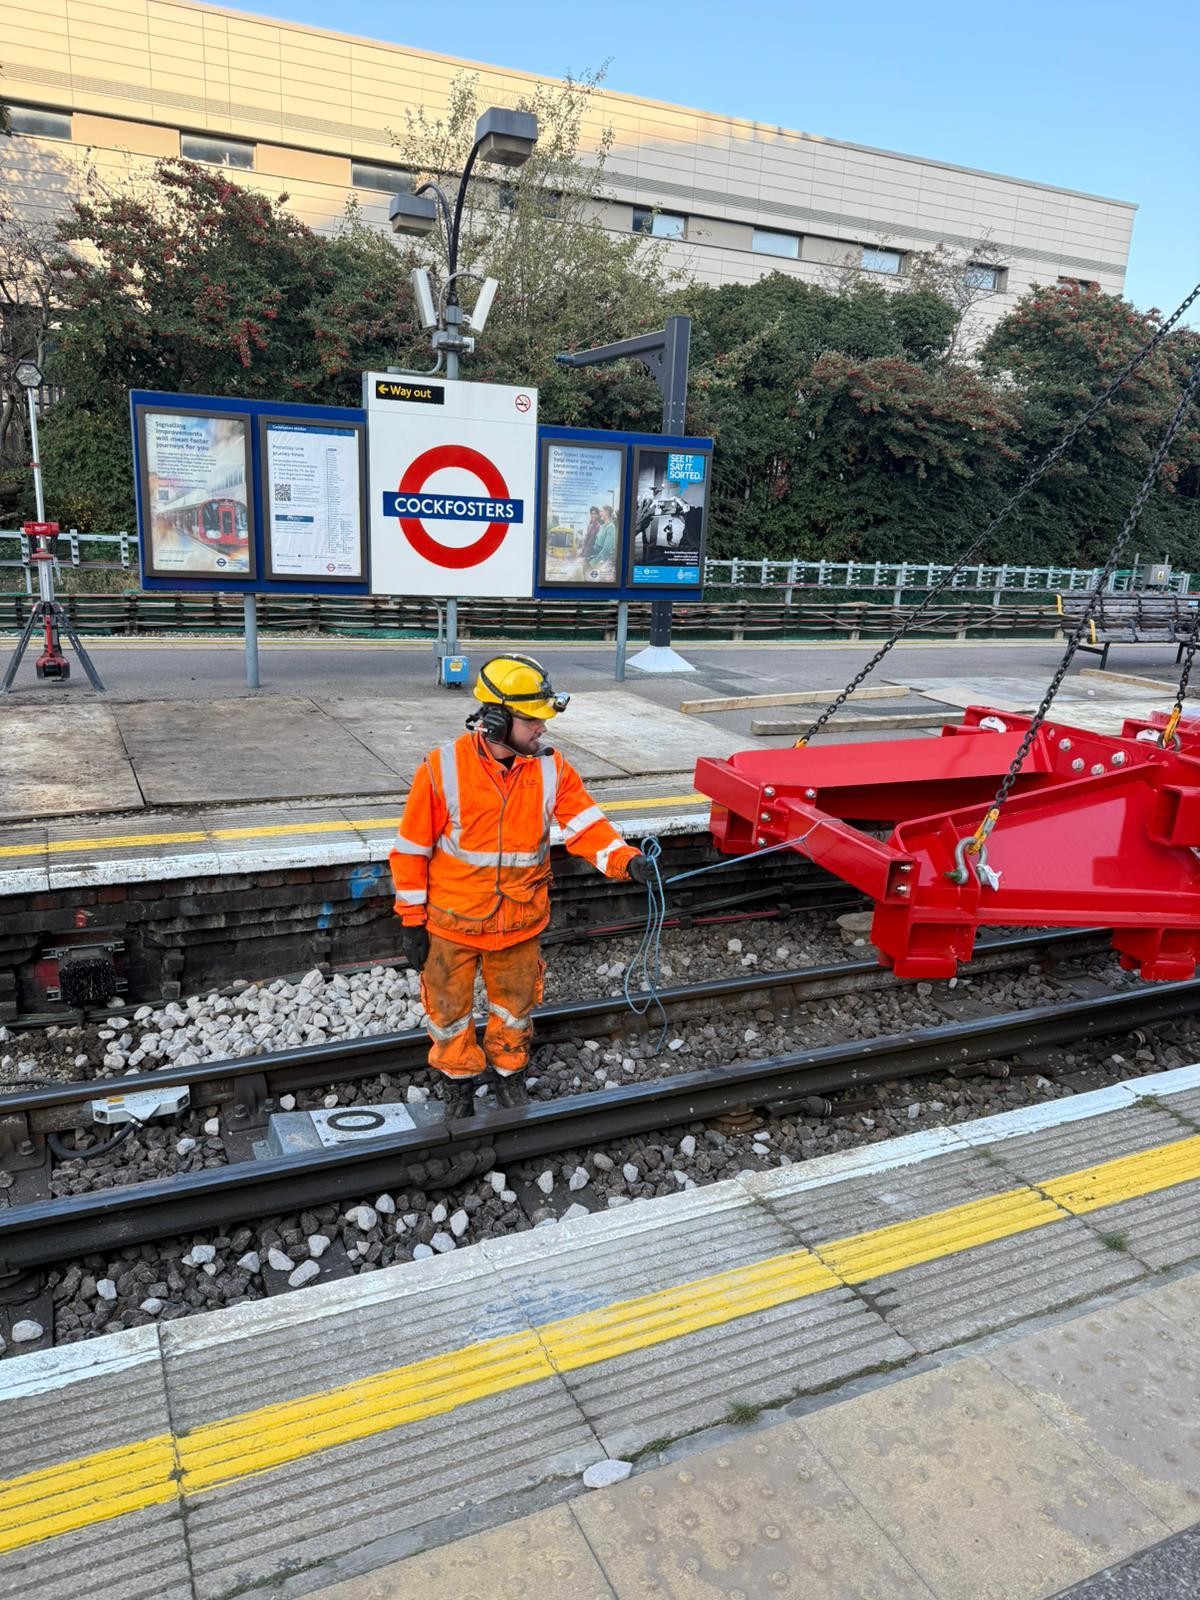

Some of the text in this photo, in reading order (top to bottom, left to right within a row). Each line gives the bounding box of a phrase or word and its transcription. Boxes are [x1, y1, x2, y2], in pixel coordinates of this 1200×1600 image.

[390, 384, 432, 399] Way out
[155, 421, 187, 431] Signalling
[155, 428, 203, 437] improvements
[670, 453, 694, 463] SEE IT.
[669, 462, 694, 471] SAY IT.
[669, 470, 702, 480] SORTED.
[394, 497, 514, 518] COCKFOSTERS
